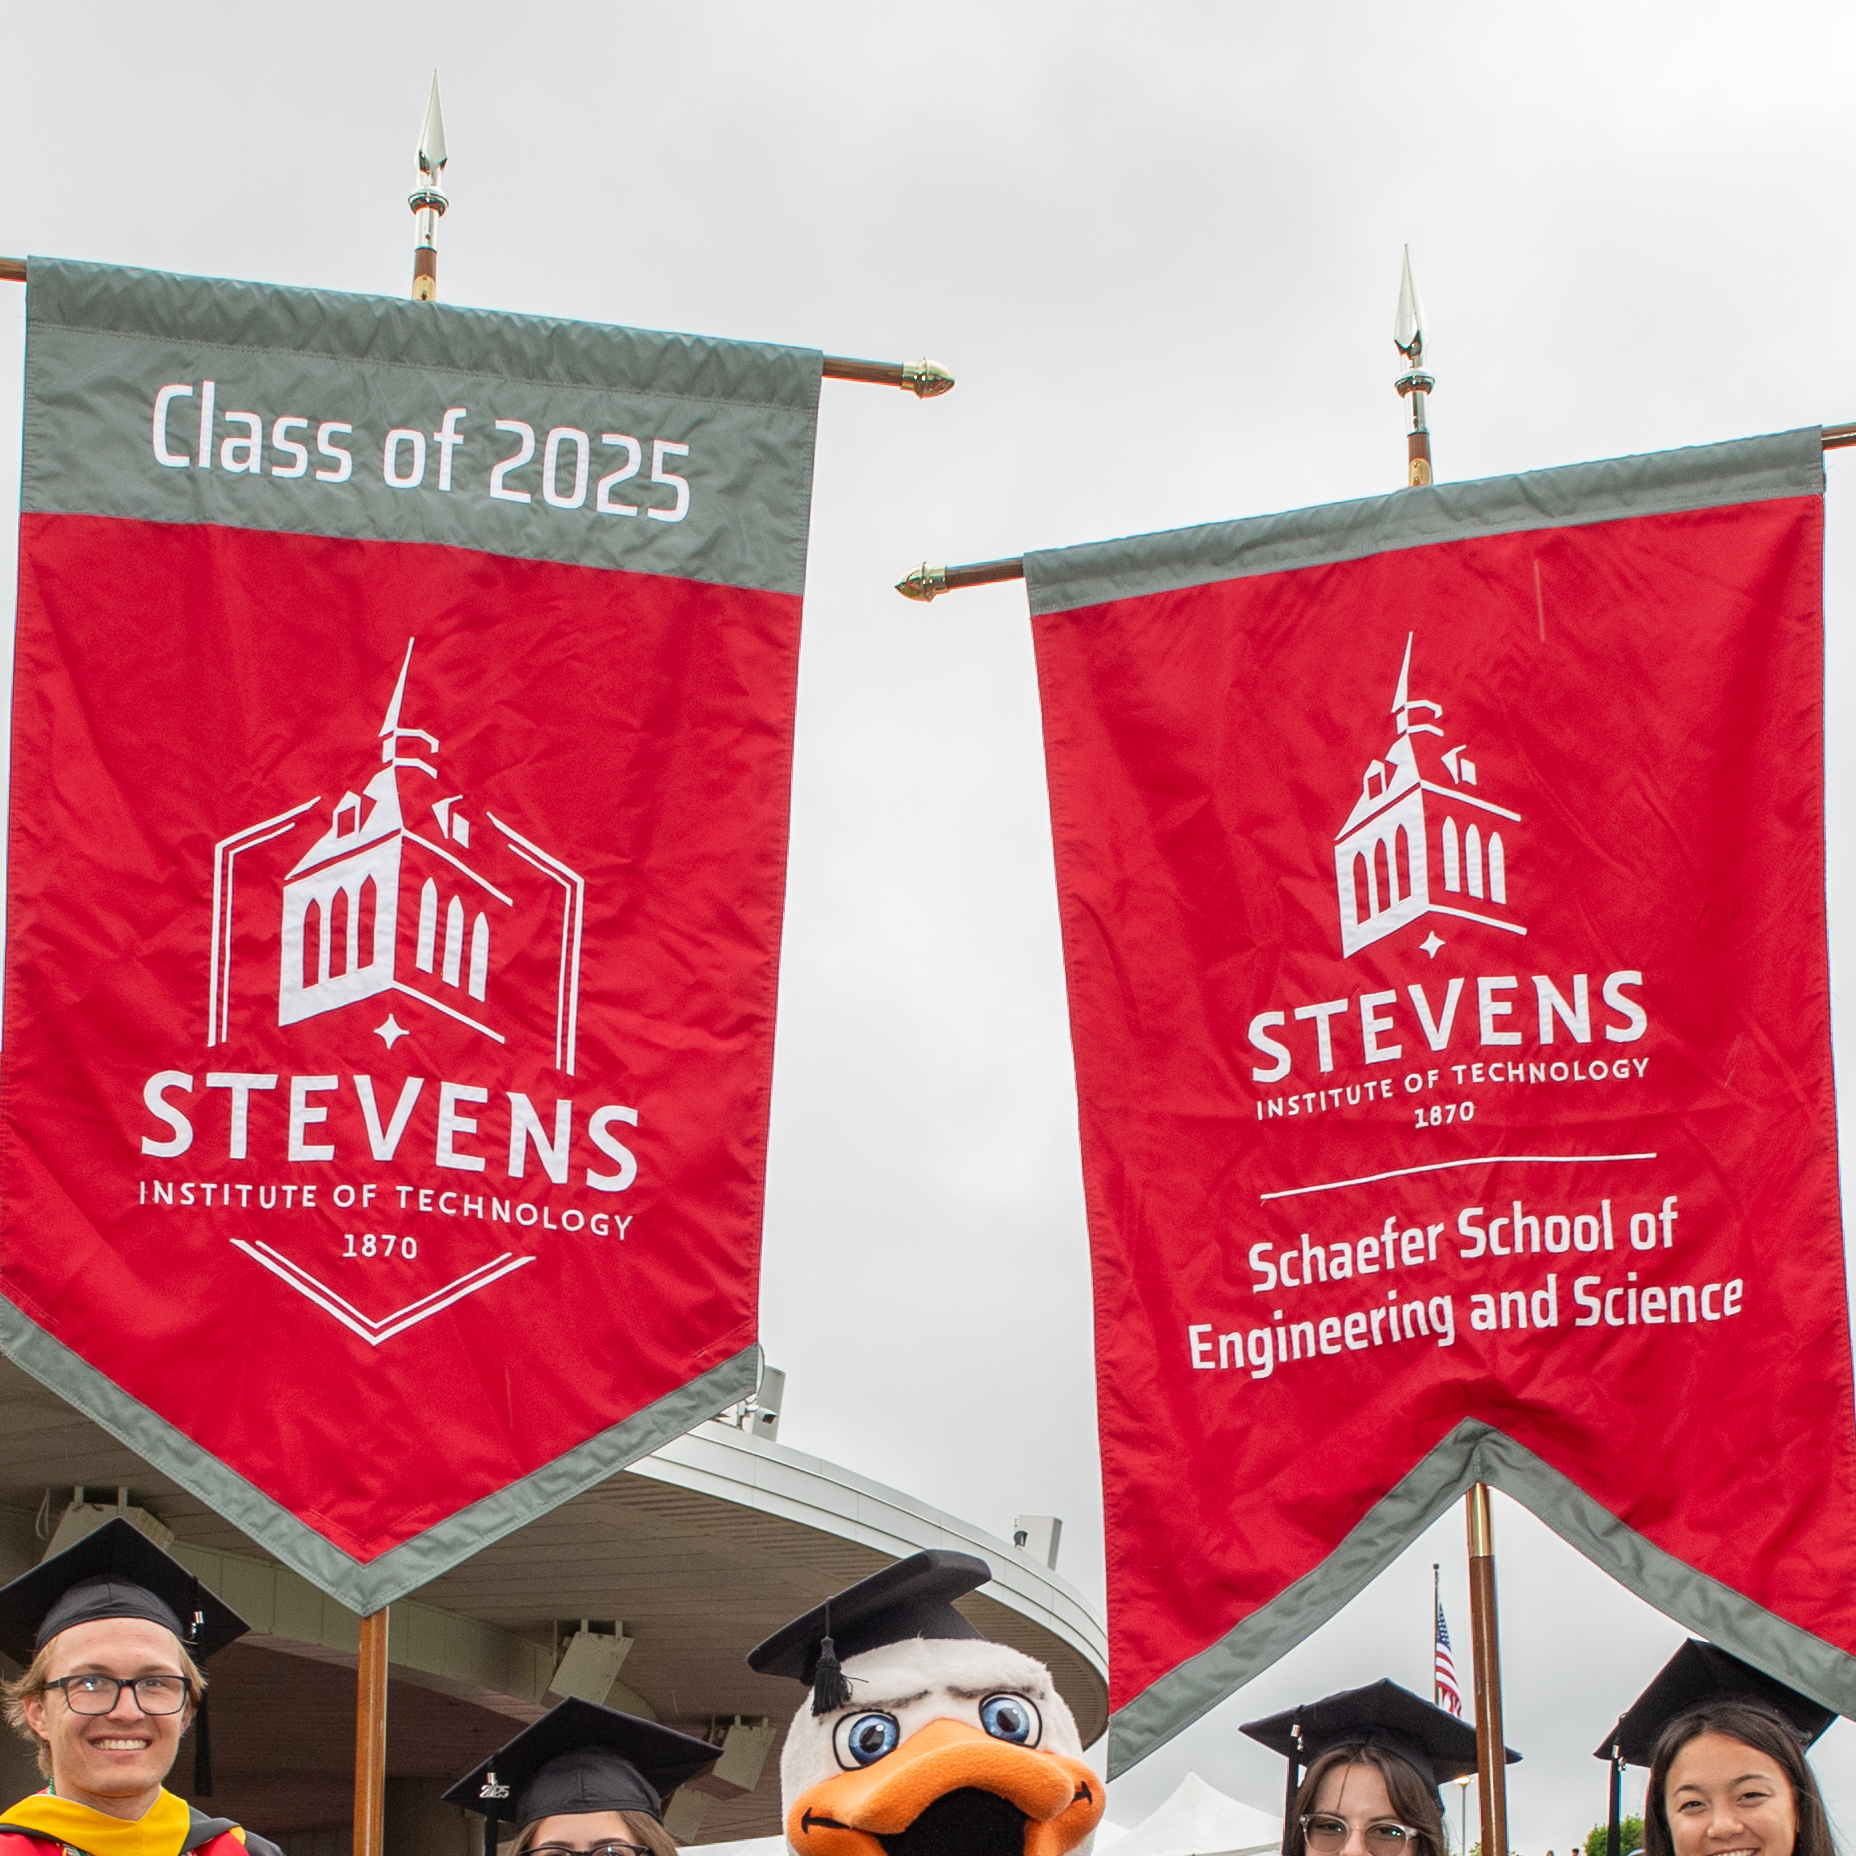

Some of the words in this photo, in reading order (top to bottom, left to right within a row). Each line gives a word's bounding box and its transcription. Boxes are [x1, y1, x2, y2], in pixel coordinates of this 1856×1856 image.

[154, 382, 351, 481] Class
[384, 409, 466, 490] of
[490, 421, 689, 521] 2025
[1248, 971, 1647, 1082] STEVENS
[142, 1070, 638, 1191] STEVENS
[1257, 1079, 1392, 1120] INSTITUTE
[1405, 1070, 1438, 1092] OF
[1452, 1058, 1648, 1084] TECHNOLOGY
[1415, 1102, 1474, 1128] 1870
[141, 1181, 316, 1208] INSTITUTE
[334, 1184, 376, 1207] OF
[396, 1186, 632, 1239] TECHNOLOGY
[343, 1234, 416, 1259] 1870
[1249, 1216, 1444, 1292] Schaefer
[1458, 1199, 1613, 1257] School
[1630, 1196, 1677, 1249] of
[1189, 1290, 1454, 1378] Engineering
[1471, 1274, 1557, 1330] and
[1574, 1271, 1742, 1326] Science
